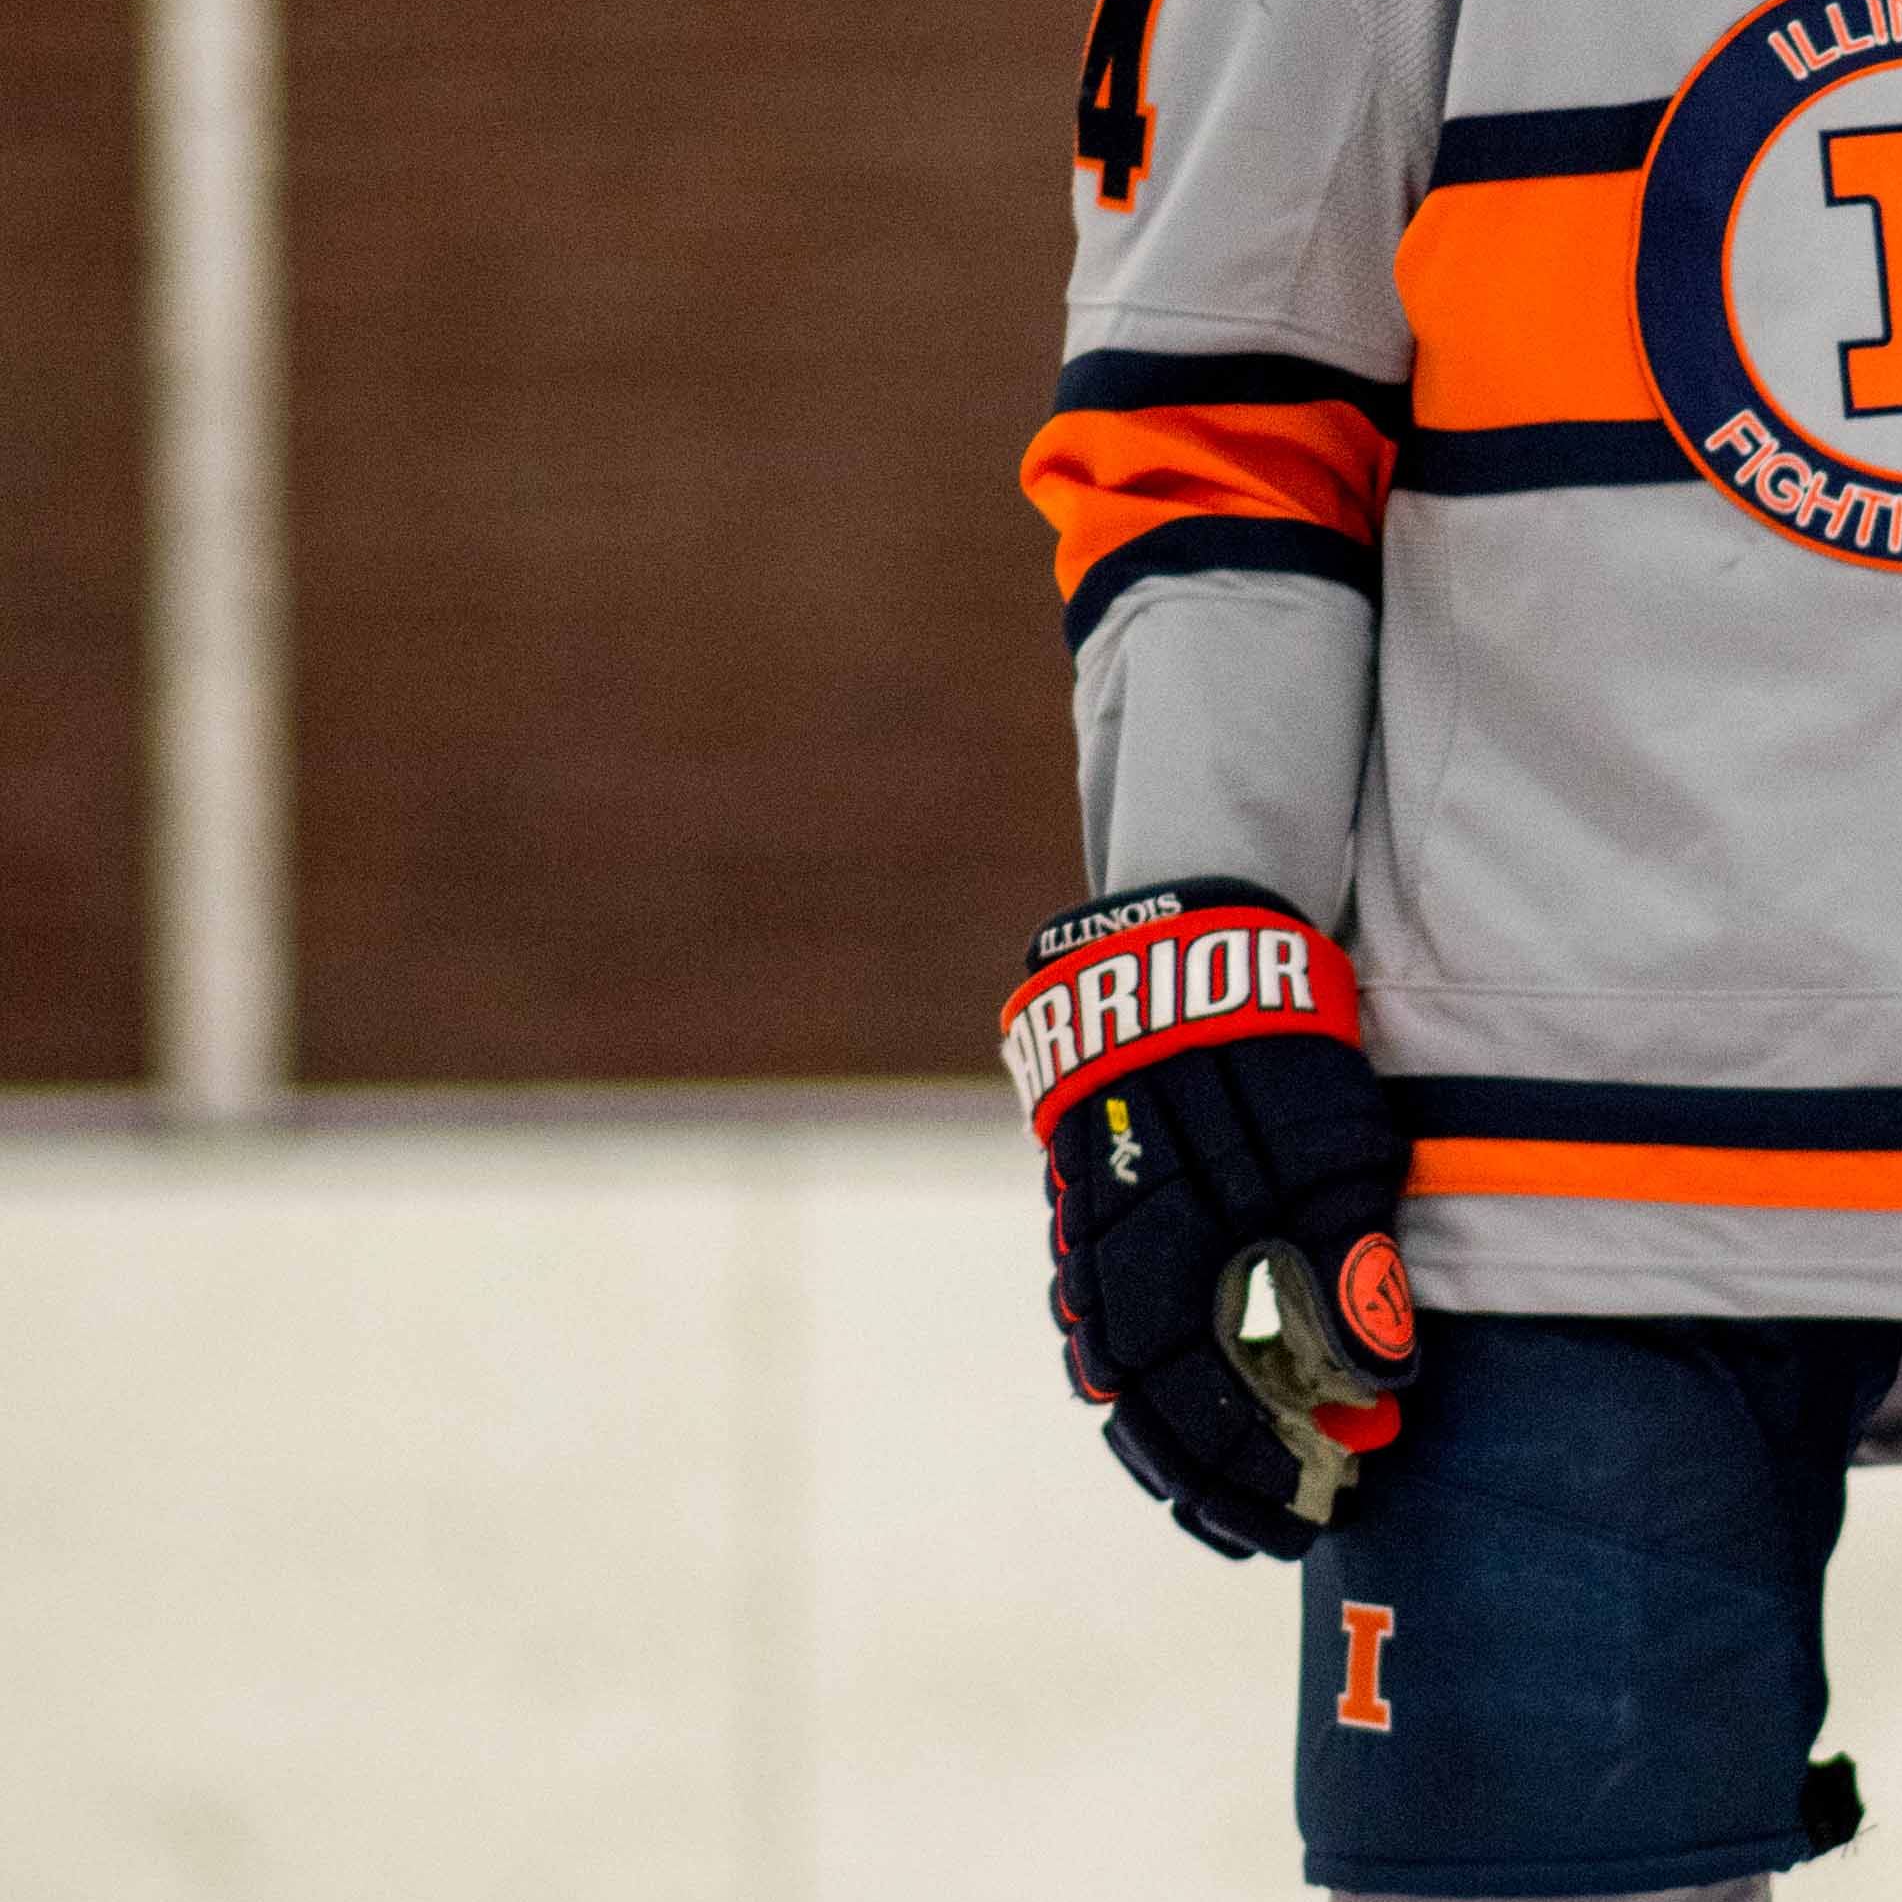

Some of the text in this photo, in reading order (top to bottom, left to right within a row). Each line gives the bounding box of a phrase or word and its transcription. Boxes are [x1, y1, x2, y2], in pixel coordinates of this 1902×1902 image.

[1040, 892, 1183, 958] ILLINOIS
[1001, 928, 1317, 1127] ARRIOR
[1336, 1600, 1395, 1731] I
